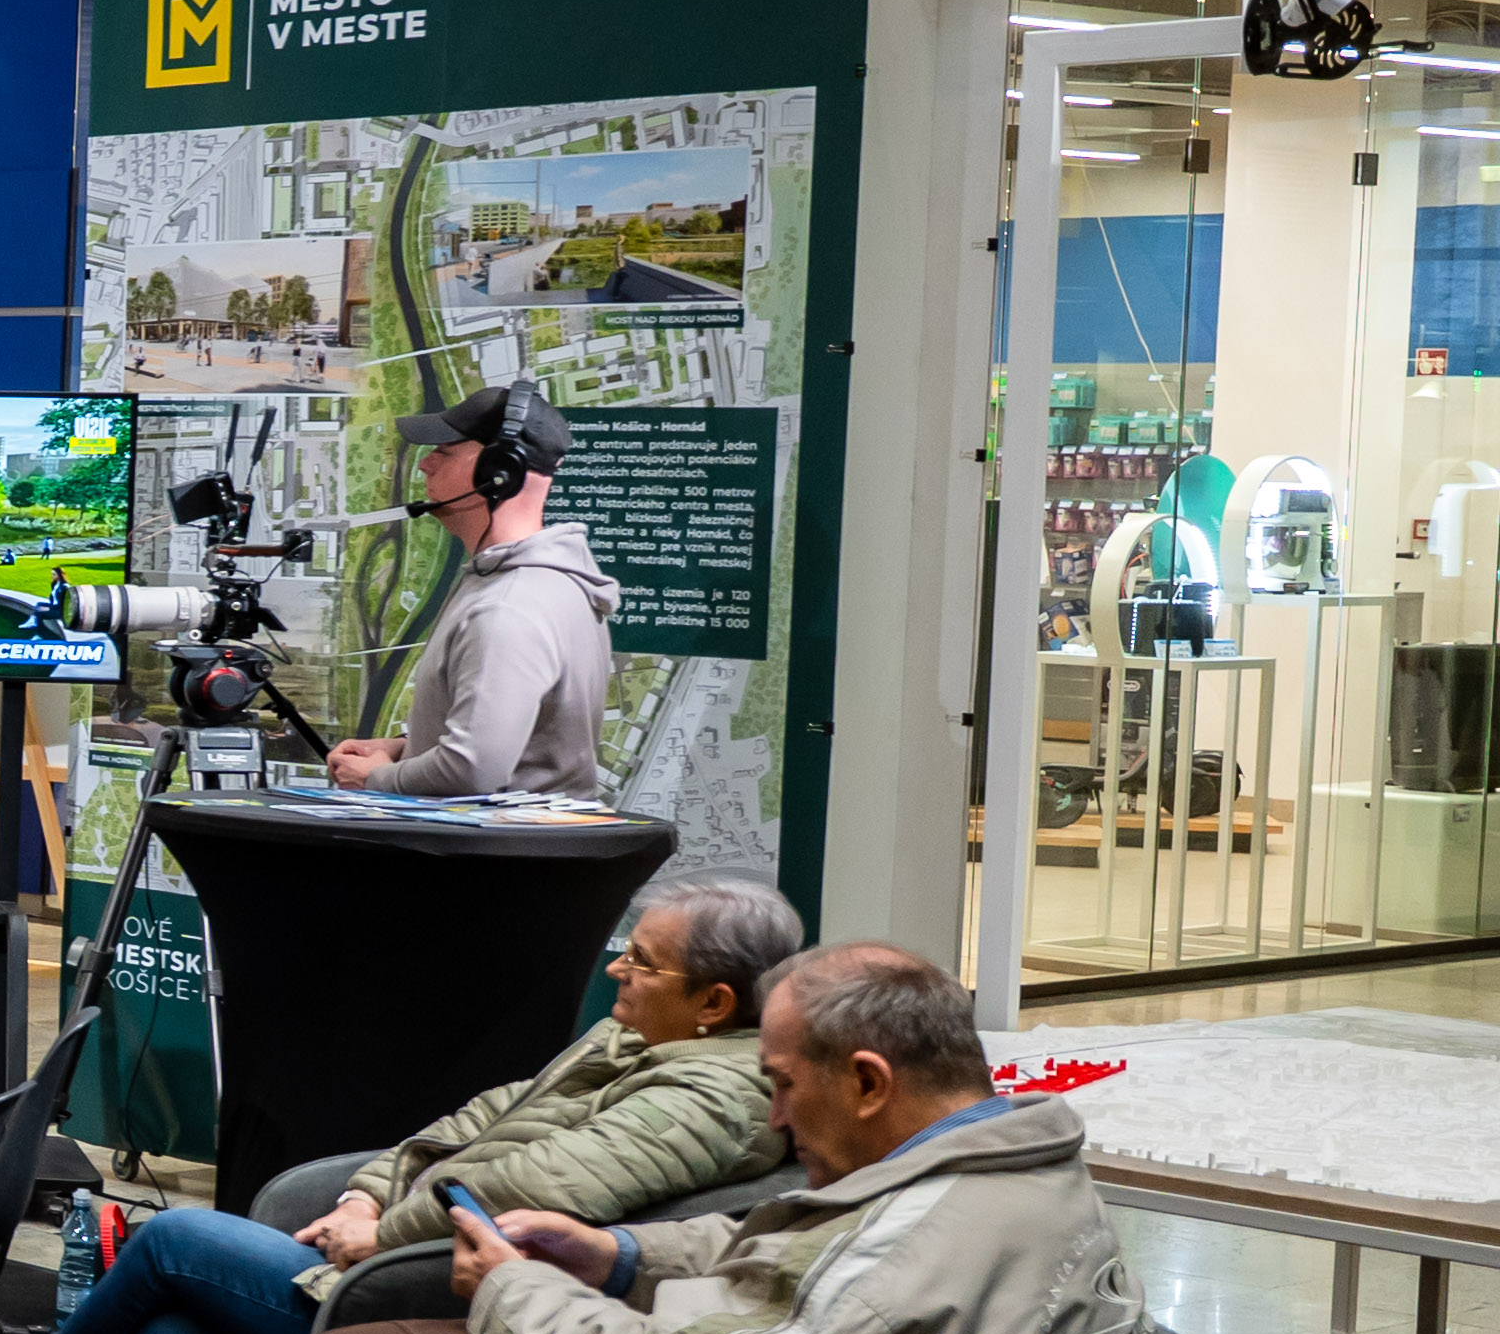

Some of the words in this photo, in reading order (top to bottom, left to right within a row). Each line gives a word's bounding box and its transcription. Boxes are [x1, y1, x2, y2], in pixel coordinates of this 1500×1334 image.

[267, 22, 297, 50] V
[301, 9, 427, 48] MESTE
[612, 421, 651, 432] Košice
[684, 486, 707, 496] 500
